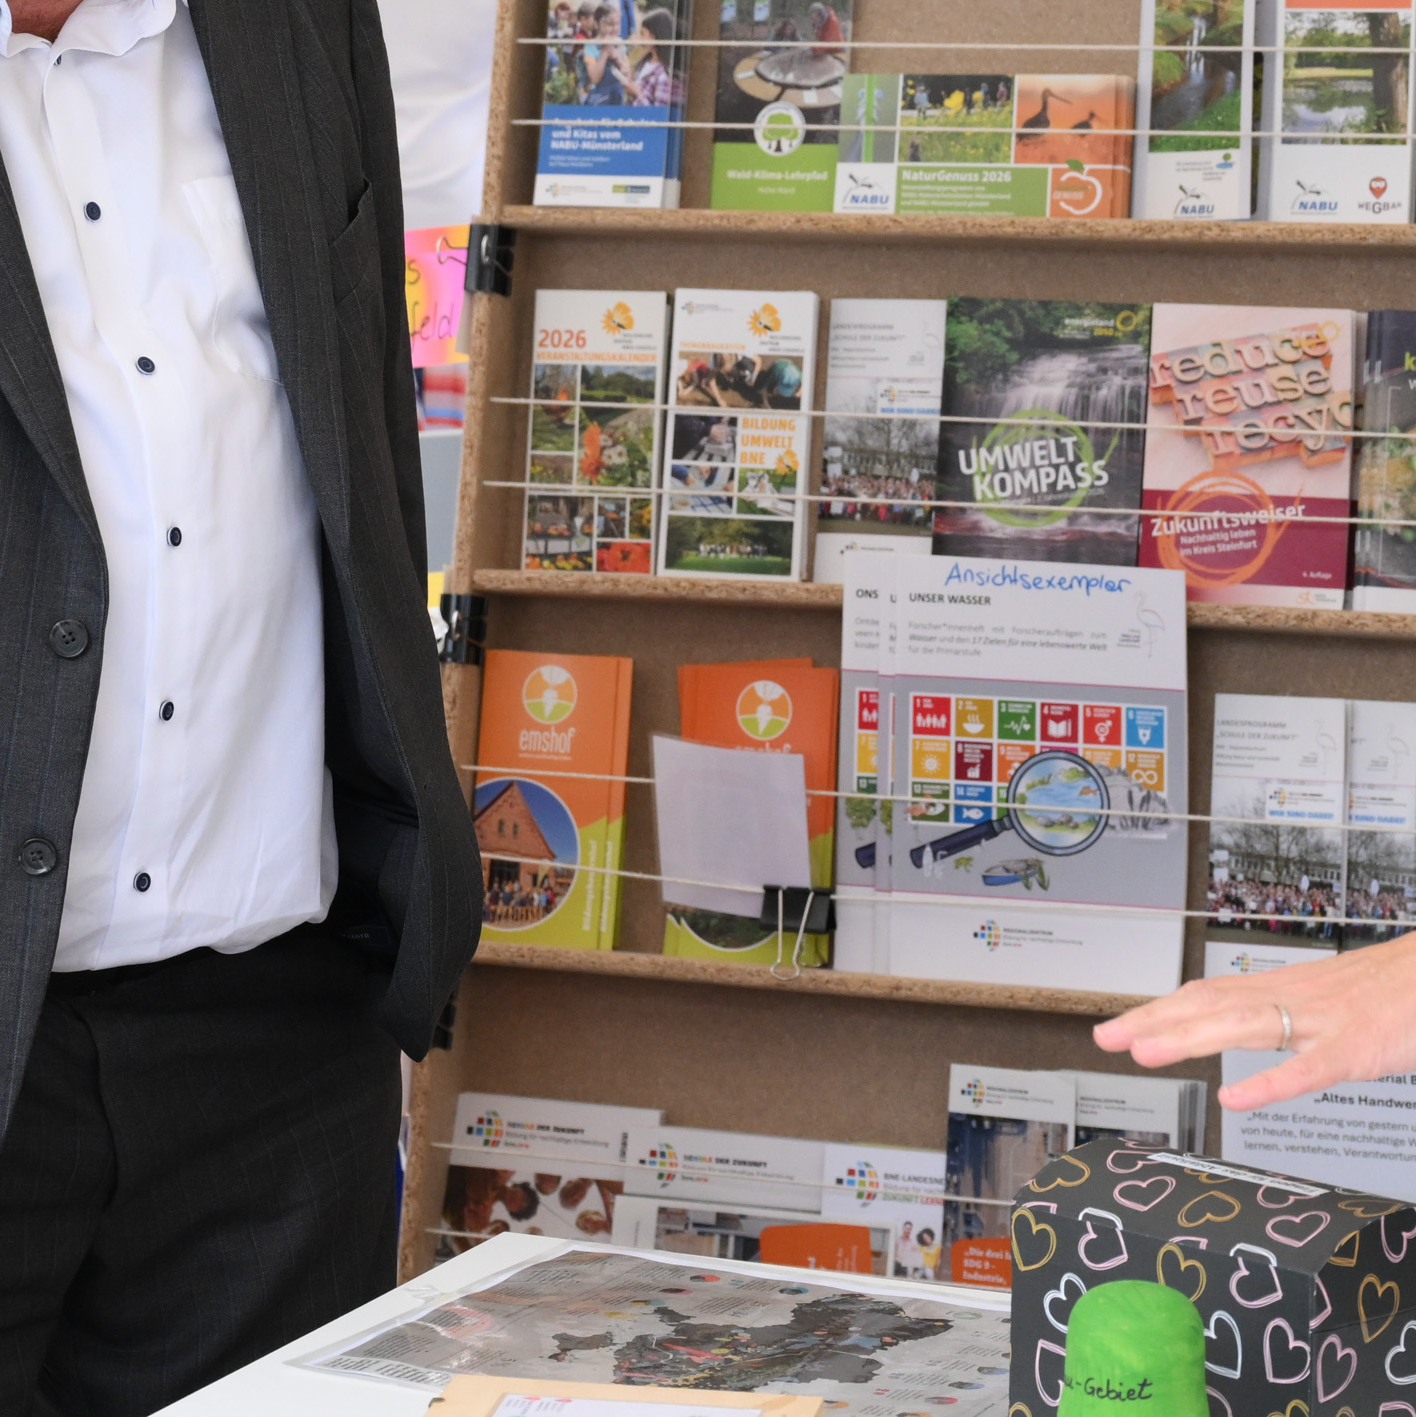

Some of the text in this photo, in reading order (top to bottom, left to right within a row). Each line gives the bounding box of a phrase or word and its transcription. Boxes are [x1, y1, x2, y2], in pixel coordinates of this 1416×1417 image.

[551, 130, 622, 140] und Kitas vom
[901, 169, 1012, 183] NaturGenuss 2026
[849, 194, 890, 205] NABU
[1298, 201, 1339, 212] NABU
[1180, 204, 1215, 215] NABU
[538, 329, 588, 349] 2026
[1150, 332, 1331, 389] reduce
[1183, 366, 1333, 421] reuse
[742, 416, 796, 432] BILDUNG
[741, 434, 794, 449] UMWELT
[740, 451, 766, 465] BNE
[957, 436, 1078, 476] UMWELT
[973, 458, 1110, 501] KOMPASS
[1150, 503, 1306, 537] Zukunftsweiser
[1179, 528, 1256, 545] Nachhaltig leben
[1179, 539, 1258, 556] im Kreis Steinfurt
[908, 593, 992, 606] UNSER WASSER
[971, 636, 983, 645] 17
[518, 724, 576, 754] emshof
[1313, 1092, 1355, 1106] „Altes
[1247, 1111, 1269, 1122] „Mit
[1270, 1113, 1289, 1123] der
[1291, 1114, 1345, 1129] Erfahrung
[1345, 1119, 1366, 1128] von
[1367, 1120, 1409, 1133] gestern
[1240, 1126, 1260, 1135] von
[1262, 1127, 1296, 1138] heute,
[1298, 1129, 1314, 1140] für
[1315, 1131, 1341, 1142] eine
[1342, 1131, 1406, 1148] nachhaltige
[1242, 1139, 1282, 1153] lernen,
[1284, 1143, 1341, 1157] verstehen,
[985, 1248, 1004, 1259] drei
